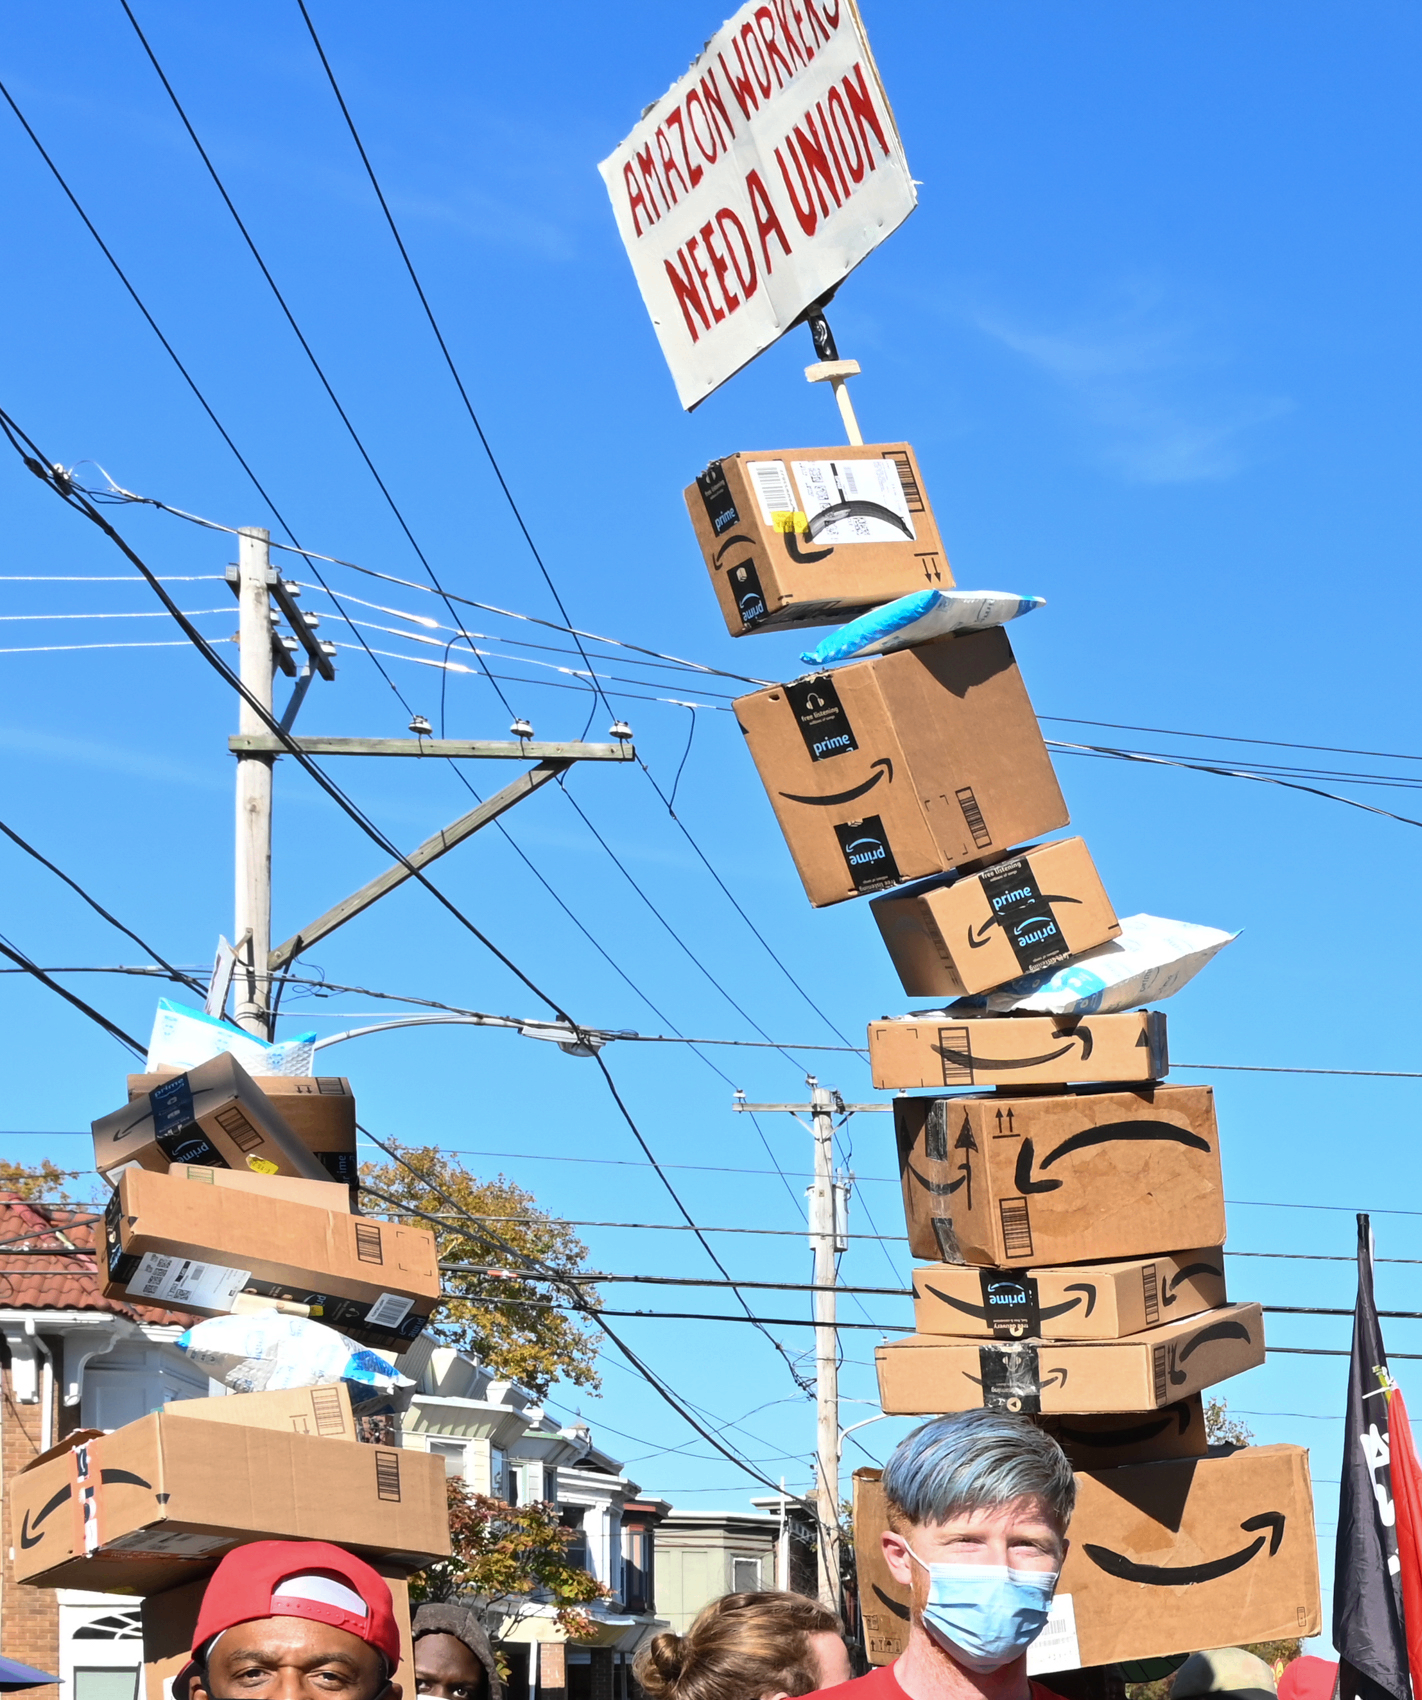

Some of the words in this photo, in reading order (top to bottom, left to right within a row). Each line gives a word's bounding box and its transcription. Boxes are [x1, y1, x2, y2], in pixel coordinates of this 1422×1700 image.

[623, 66, 736, 238] AMAZON
[663, 207, 758, 344] NEED
[745, 168, 792, 276] A
[773, 61, 890, 237] UNION
[714, 507, 736, 532] prime
[813, 734, 851, 757] prime
[849, 845, 886, 866] prime
[992, 886, 1032, 911] prime
[1018, 922, 1057, 947] prime
[989, 1291, 1026, 1307] prime
